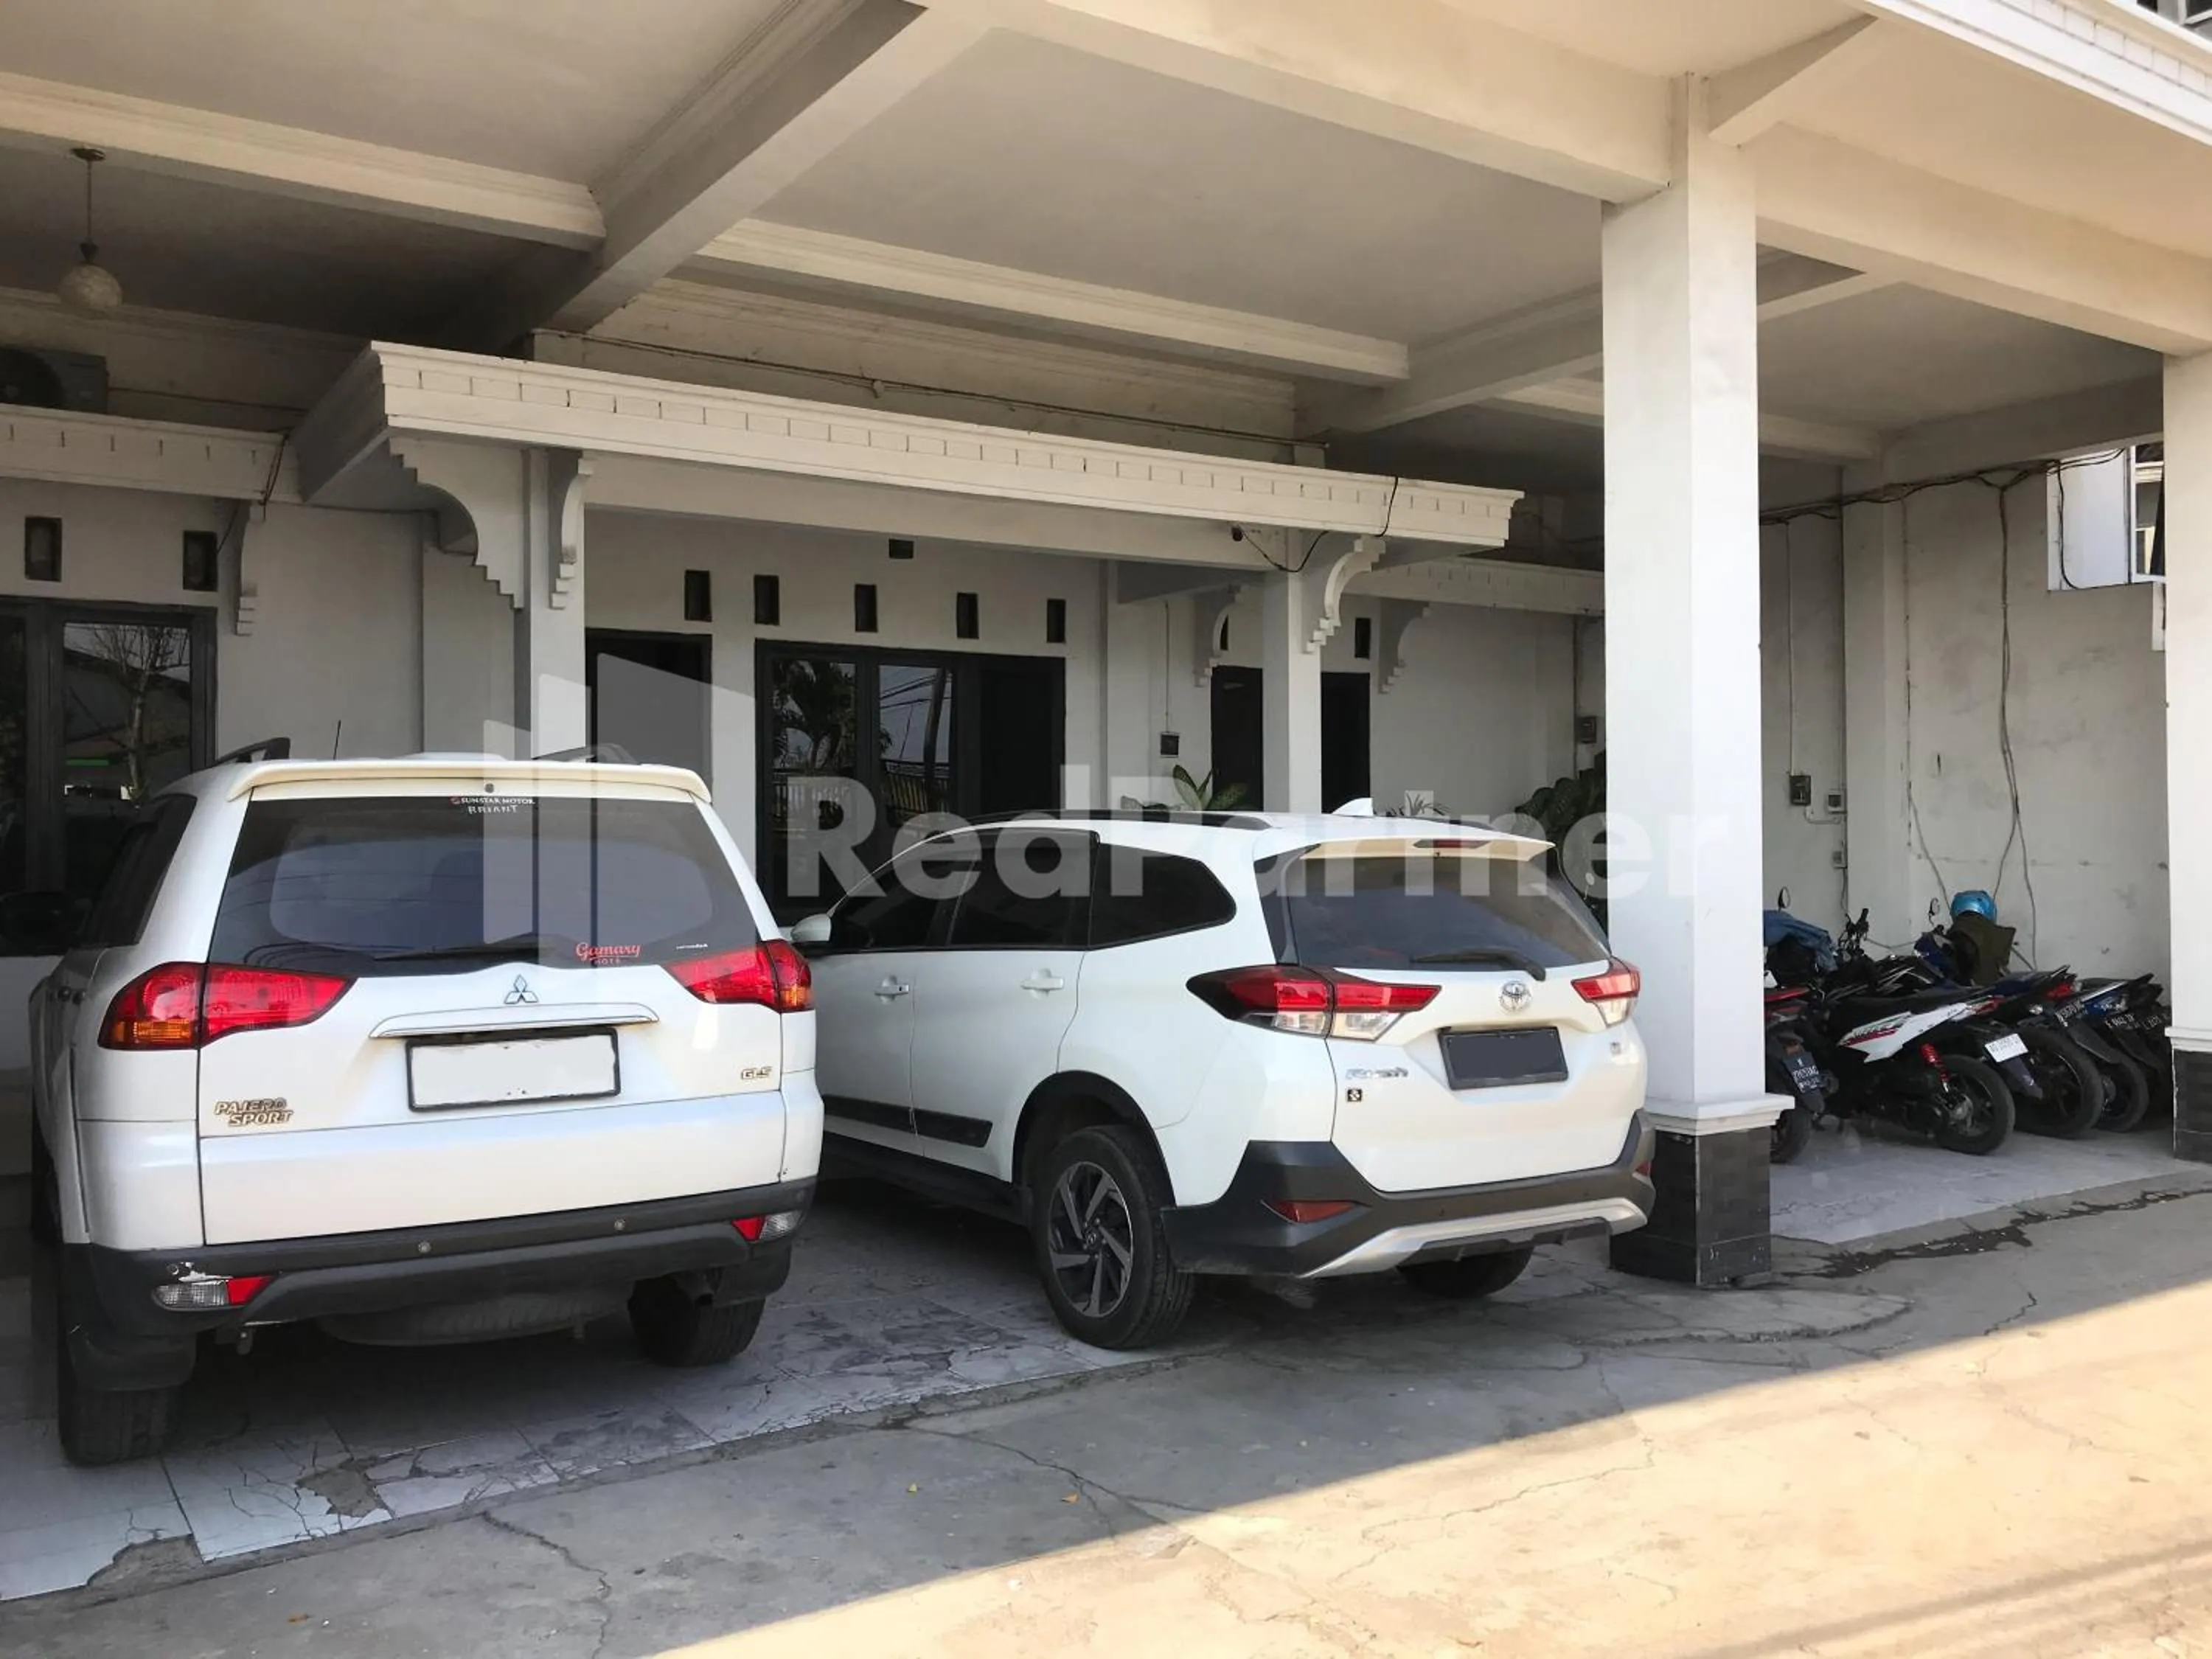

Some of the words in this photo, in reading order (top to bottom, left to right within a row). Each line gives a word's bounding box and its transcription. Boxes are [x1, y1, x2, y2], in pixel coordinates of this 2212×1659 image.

[461, 796, 501, 804] SUNSTAR
[215, 1097, 287, 1115] PAJERO
[228, 1110, 294, 1127] SPORT
